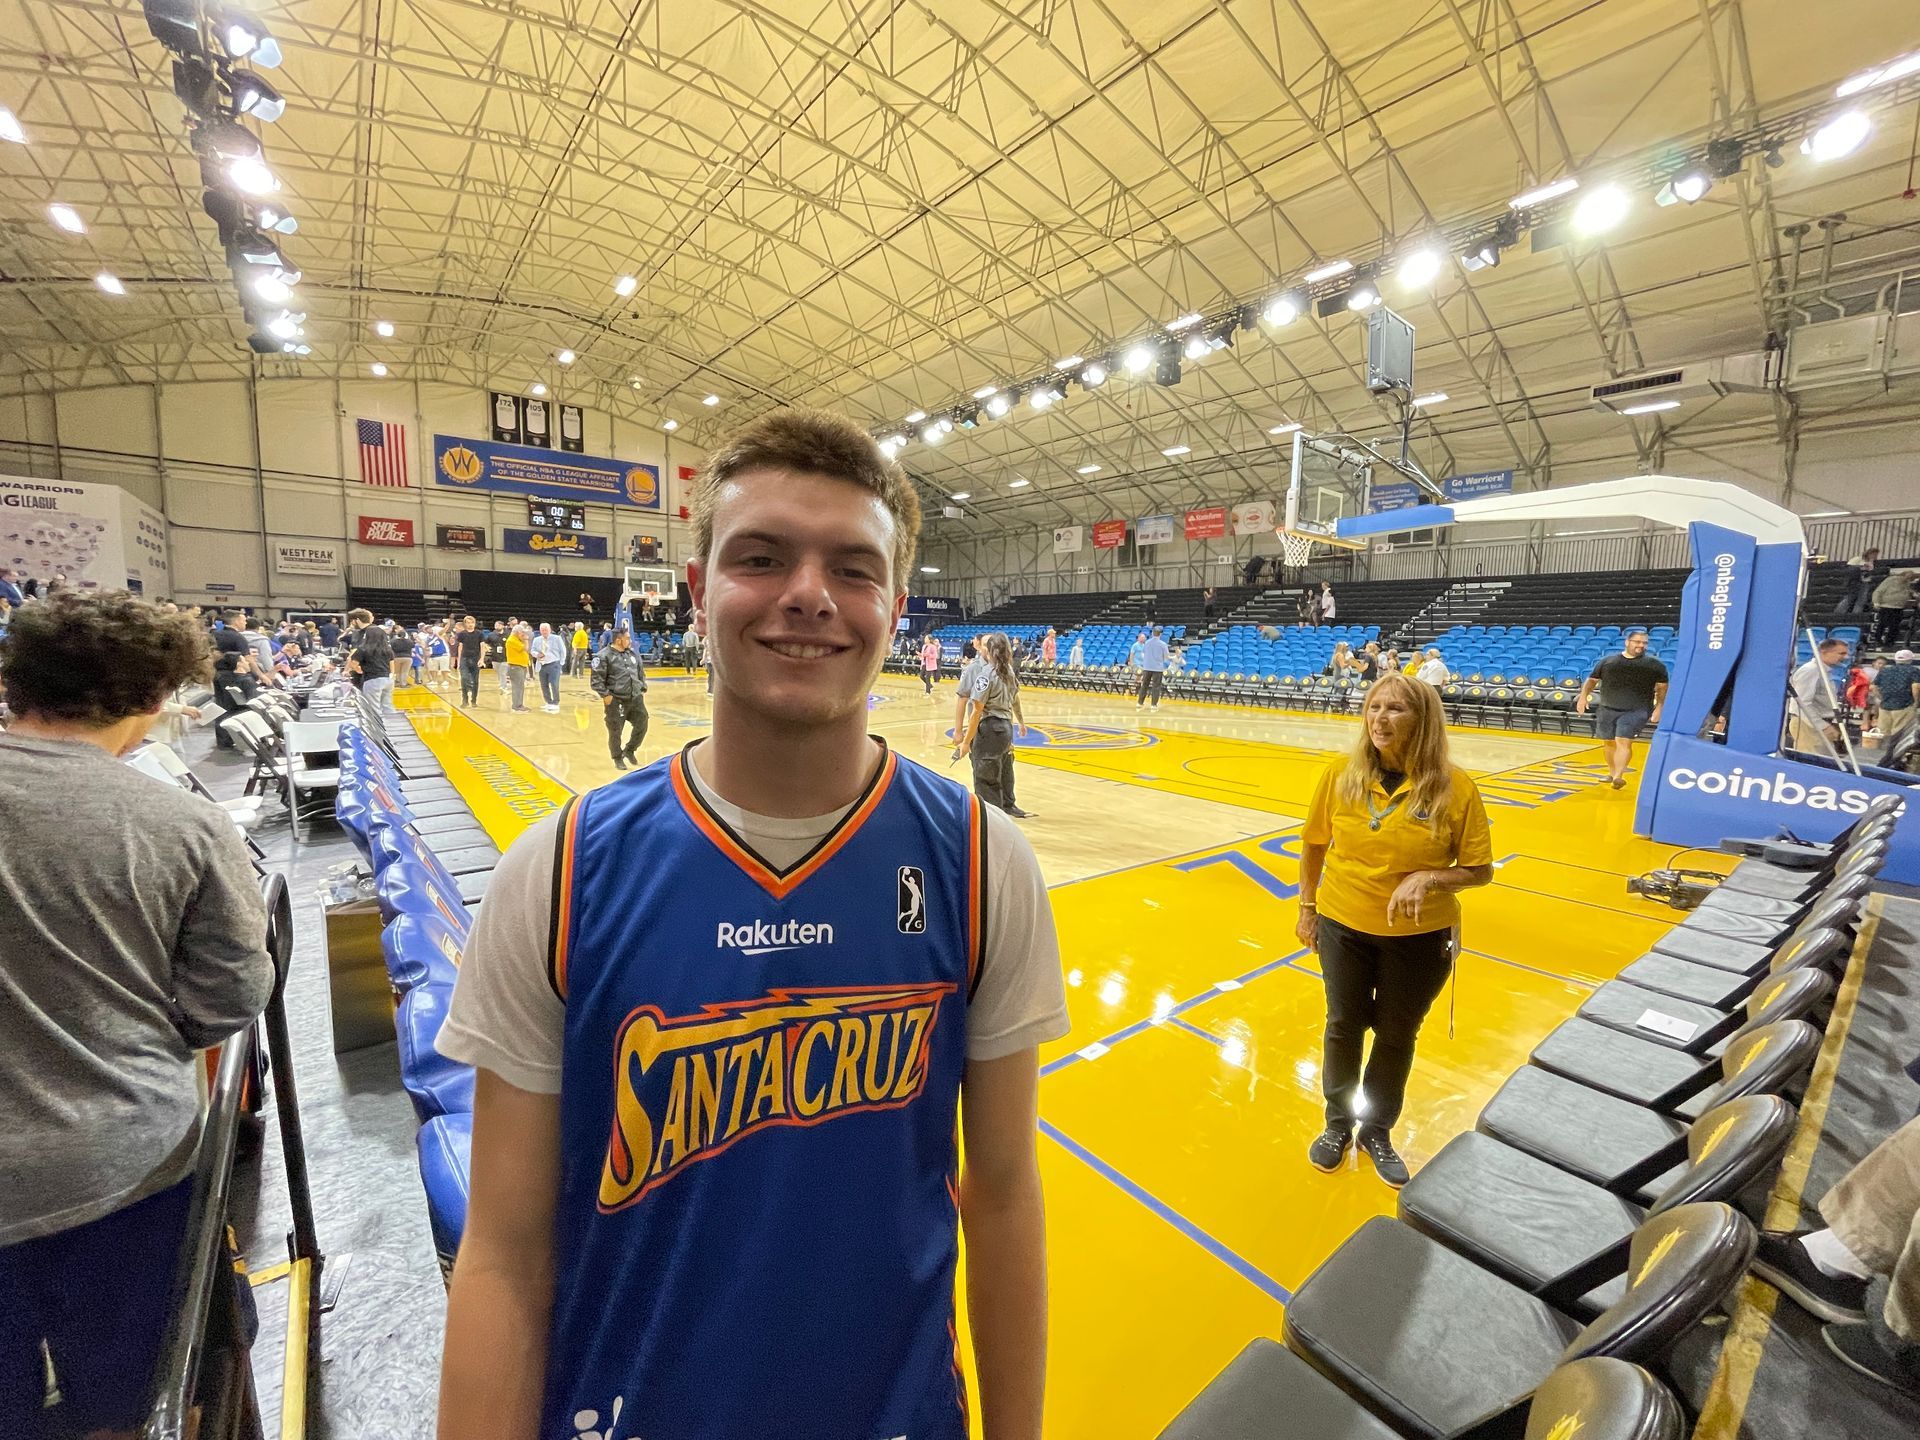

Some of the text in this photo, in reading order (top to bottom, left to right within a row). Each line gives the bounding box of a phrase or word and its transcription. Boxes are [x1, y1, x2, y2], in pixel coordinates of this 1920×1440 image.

[529, 404, 542, 412] 105
[491, 460, 505, 468] THE
[506, 462, 538, 472] OFFICIAL
[562, 470, 588, 478] LEAGUE
[589, 474, 620, 482] AFFILIATE
[511, 470, 524, 478] THE
[526, 472, 555, 481] GOLDEN
[557, 476, 578, 484] STATE
[579, 479, 615, 489] WARRIORS
[1452, 473, 1505, 487] Go Warriors!
[0, 482, 84, 495] WARRIORS
[370, 521, 399, 532] SHOE
[533, 516, 545, 526] 99
[366, 529, 408, 542] PALACE
[279, 547, 334, 560] WEST PEAK
[926, 599, 948, 609] Modelo
[1707, 553, 1736, 650] @nbagleague
[914, 919, 923, 929] G
[717, 919, 834, 949] Rakuten
[599, 1006, 935, 1208] SANTA CRUZ
